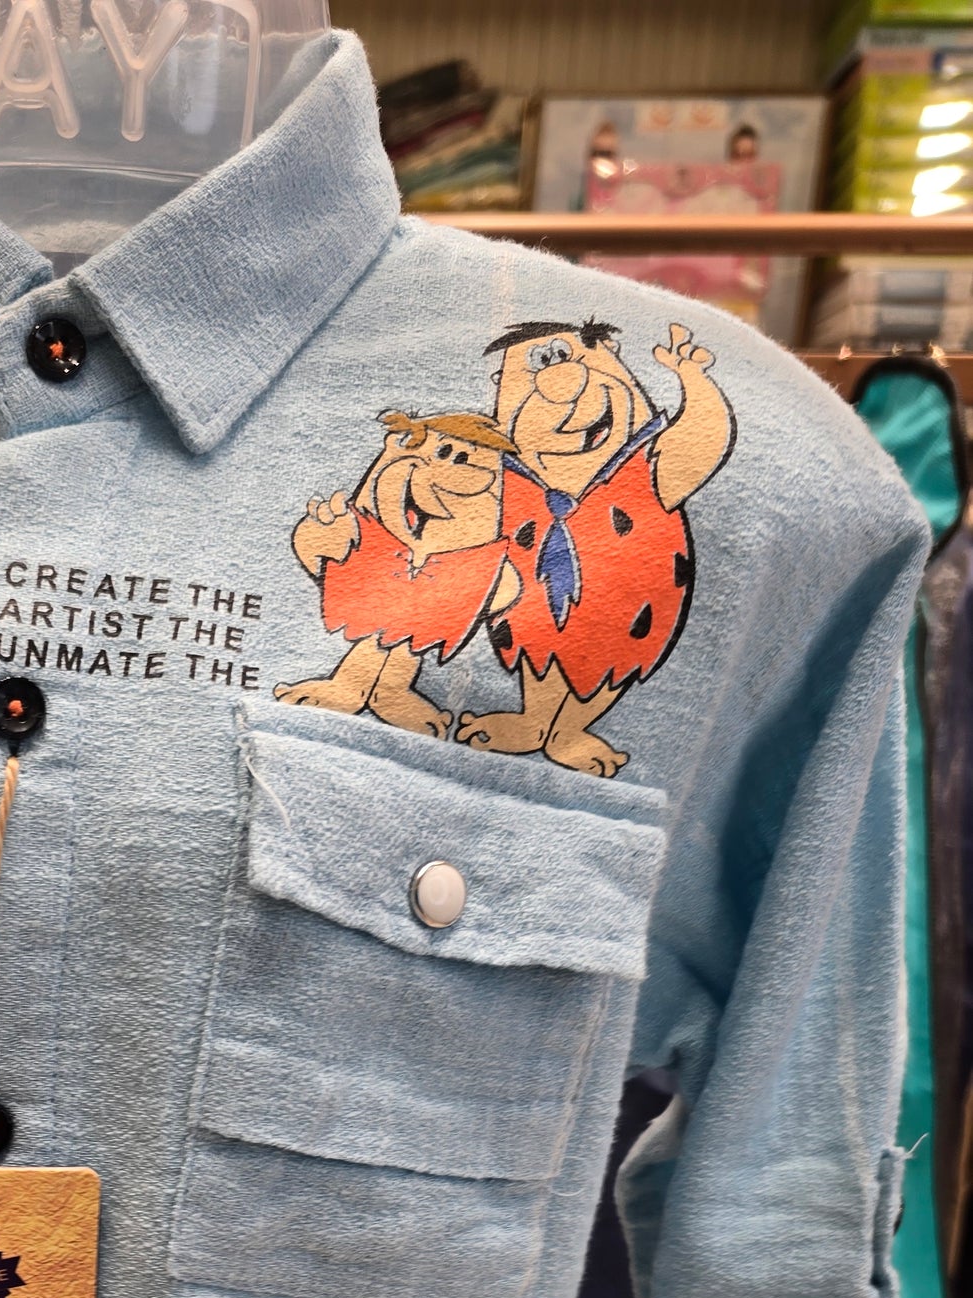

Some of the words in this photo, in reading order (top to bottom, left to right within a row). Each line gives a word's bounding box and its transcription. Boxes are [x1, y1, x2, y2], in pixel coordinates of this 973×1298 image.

[5, 561, 172, 604] CREATE
[188, 583, 263, 620] THE
[169, 616, 245, 652] THE
[185, 653, 260, 691] THE
